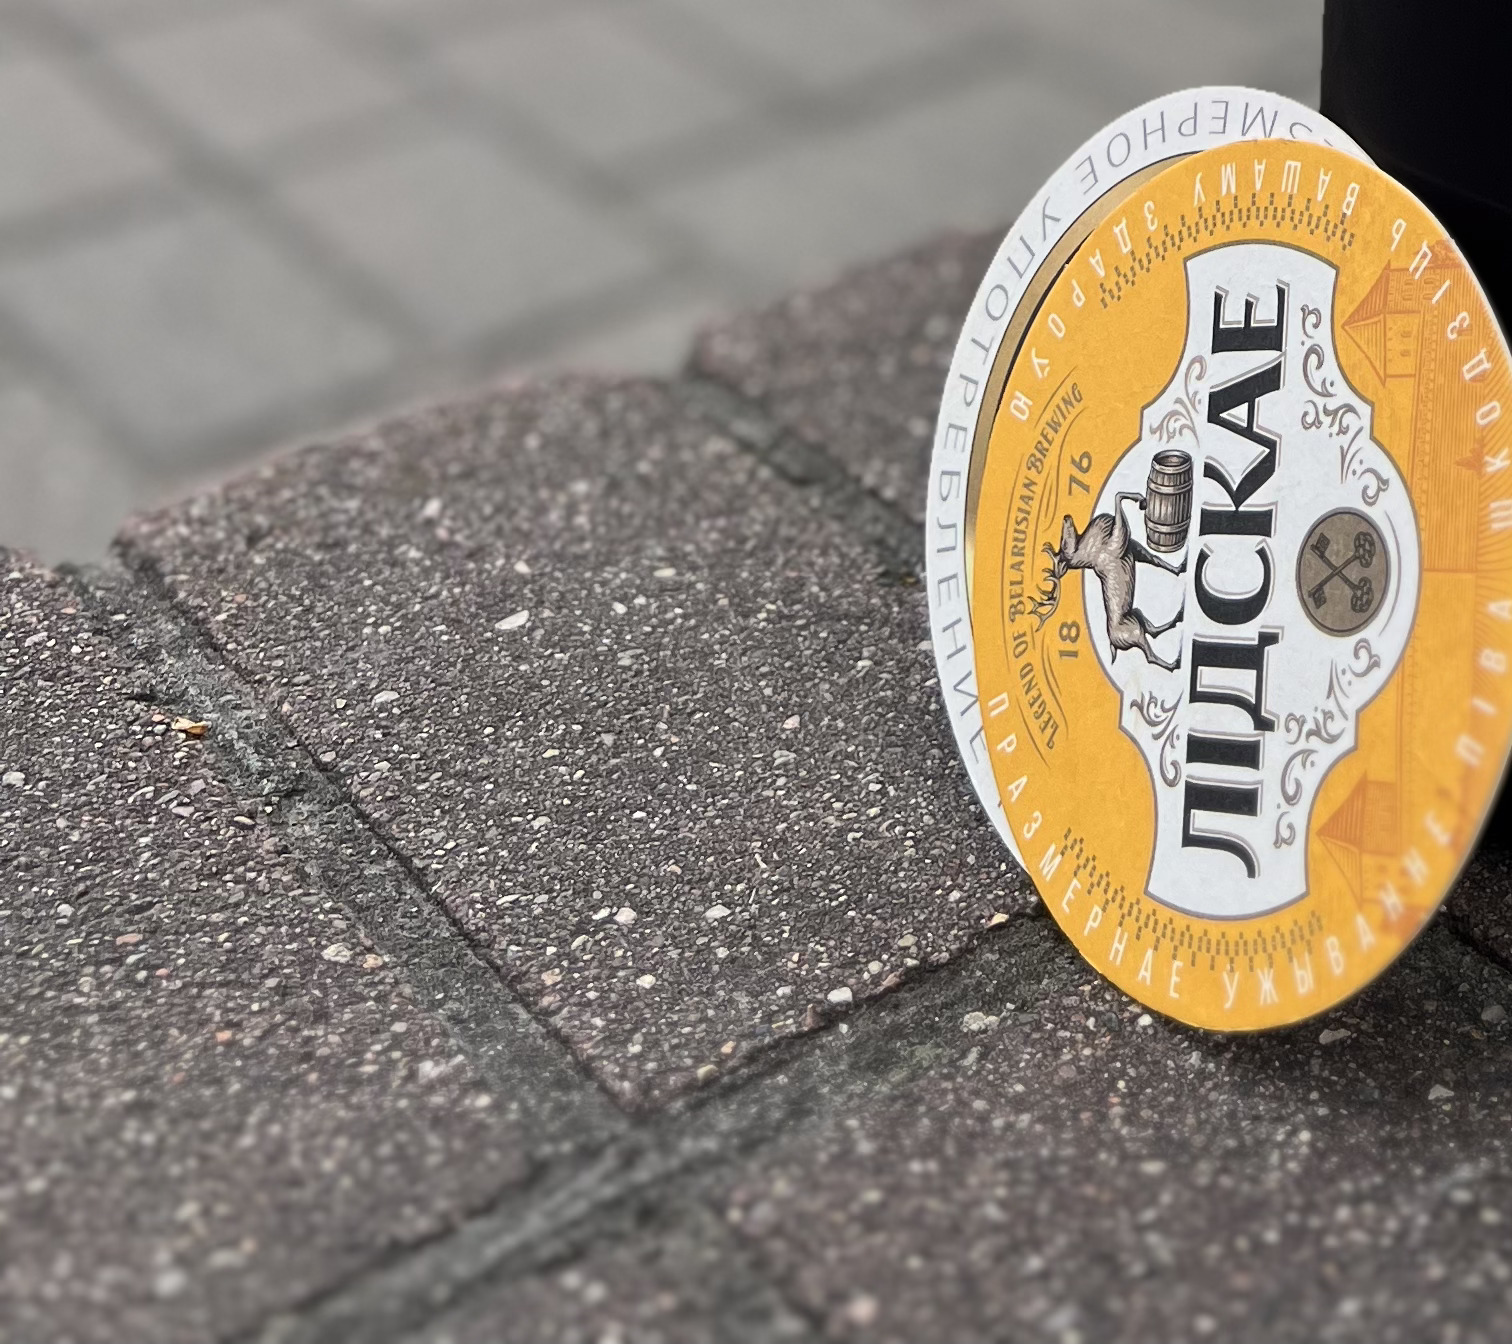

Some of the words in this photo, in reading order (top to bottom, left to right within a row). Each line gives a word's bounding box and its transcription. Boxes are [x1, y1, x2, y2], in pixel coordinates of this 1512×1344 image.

[1192, 159, 1360, 216] ВАШАМУ
[1067, 448, 1093, 497] 76
[1057, 619, 1082, 661] 18
[1181, 278, 1290, 880] ЛІДСКАЕ
[987, 691, 1184, 1000] ПРАЗМЕРНАЕ
[1222, 809, 1451, 1010] УЖЫВАННЕ
